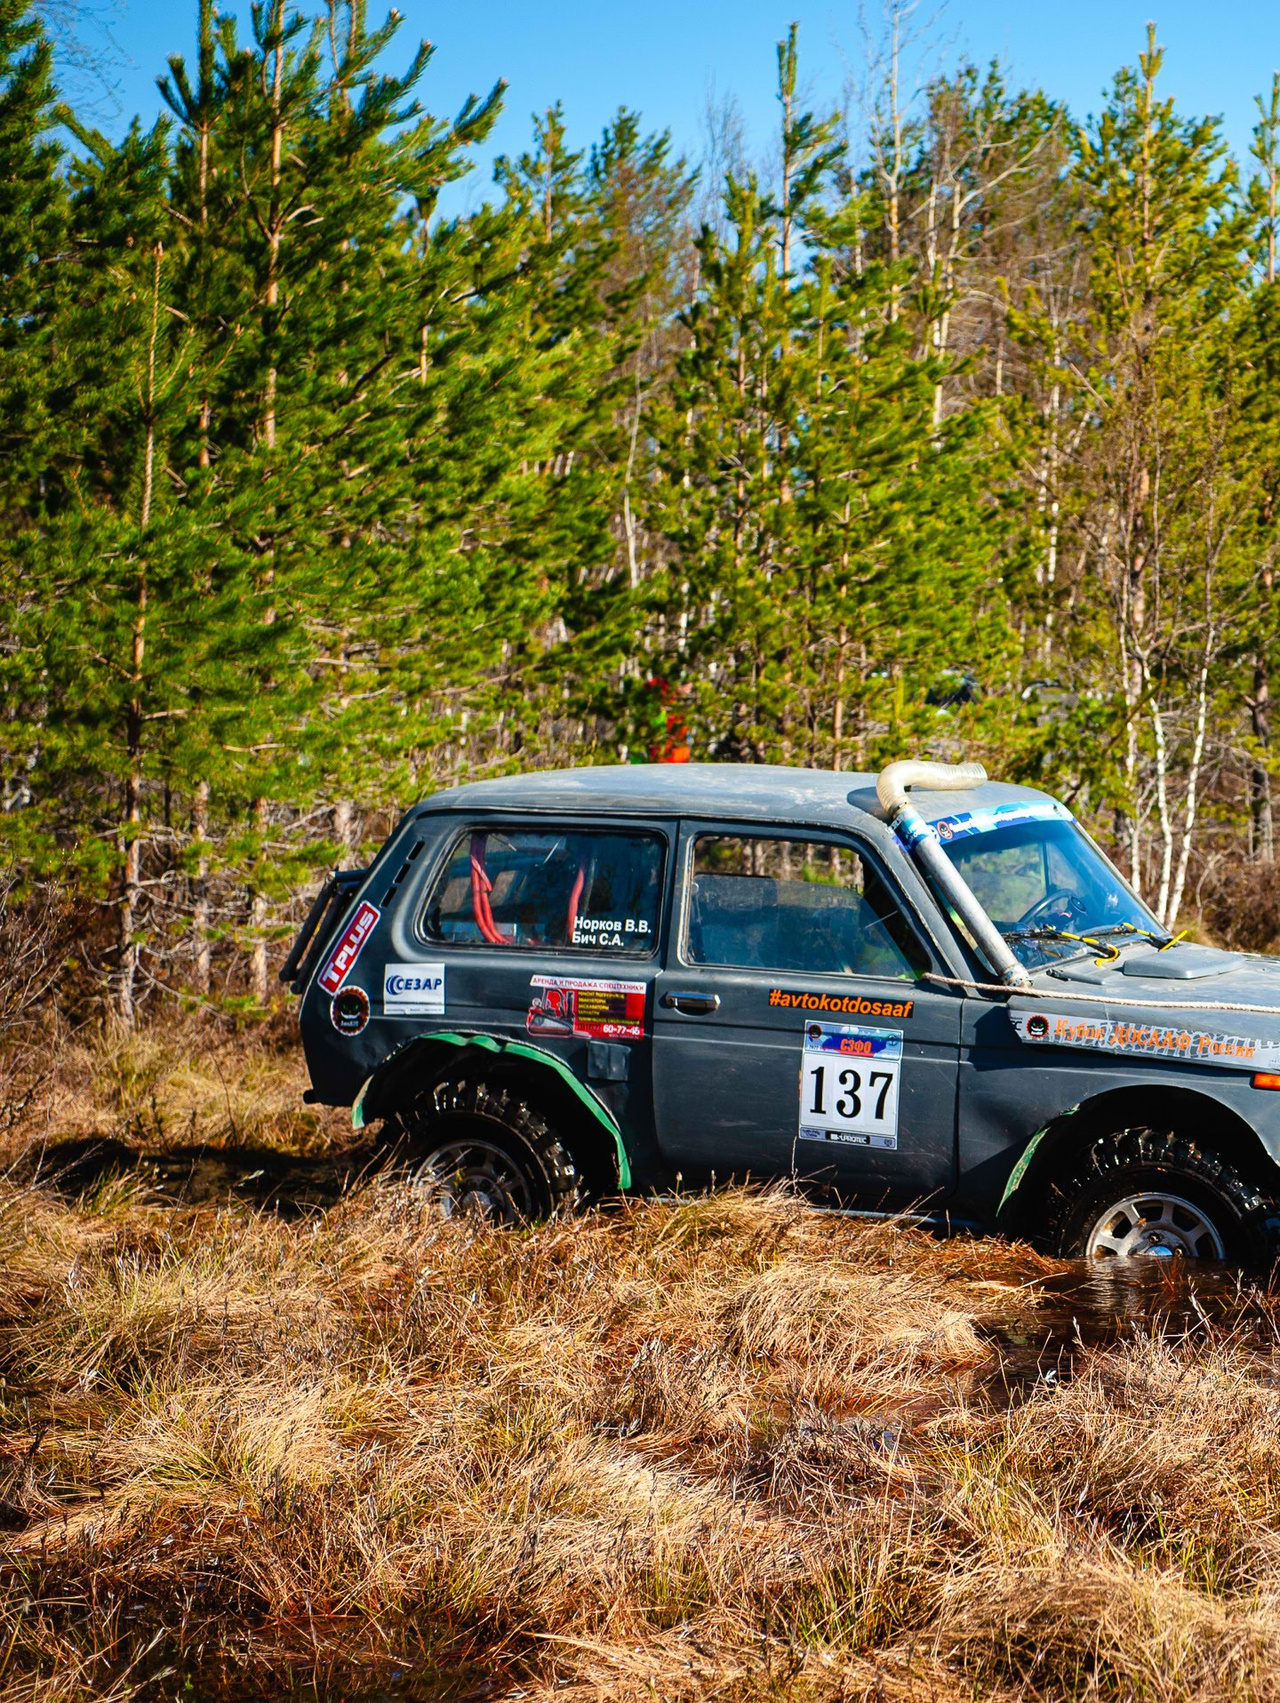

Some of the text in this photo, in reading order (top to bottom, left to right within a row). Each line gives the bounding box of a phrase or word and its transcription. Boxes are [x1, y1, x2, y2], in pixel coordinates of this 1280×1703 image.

[574, 916, 652, 934] Норков В.В.
[322, 910, 374, 983] TPLUS
[572, 931, 624, 947] Бич С.А.
[395, 977, 442, 991] СЕЗАР
[532, 977, 558, 986] АРЕНДА
[565, 979, 598, 988] ПРОДАЖА
[769, 989, 914, 1018] #avtokotdosaaf
[840, 1038, 872, 1054] СЗФО
[1055, 1018, 1256, 1059] Кубок ДОСААФ России
[810, 1066, 893, 1120] 137
